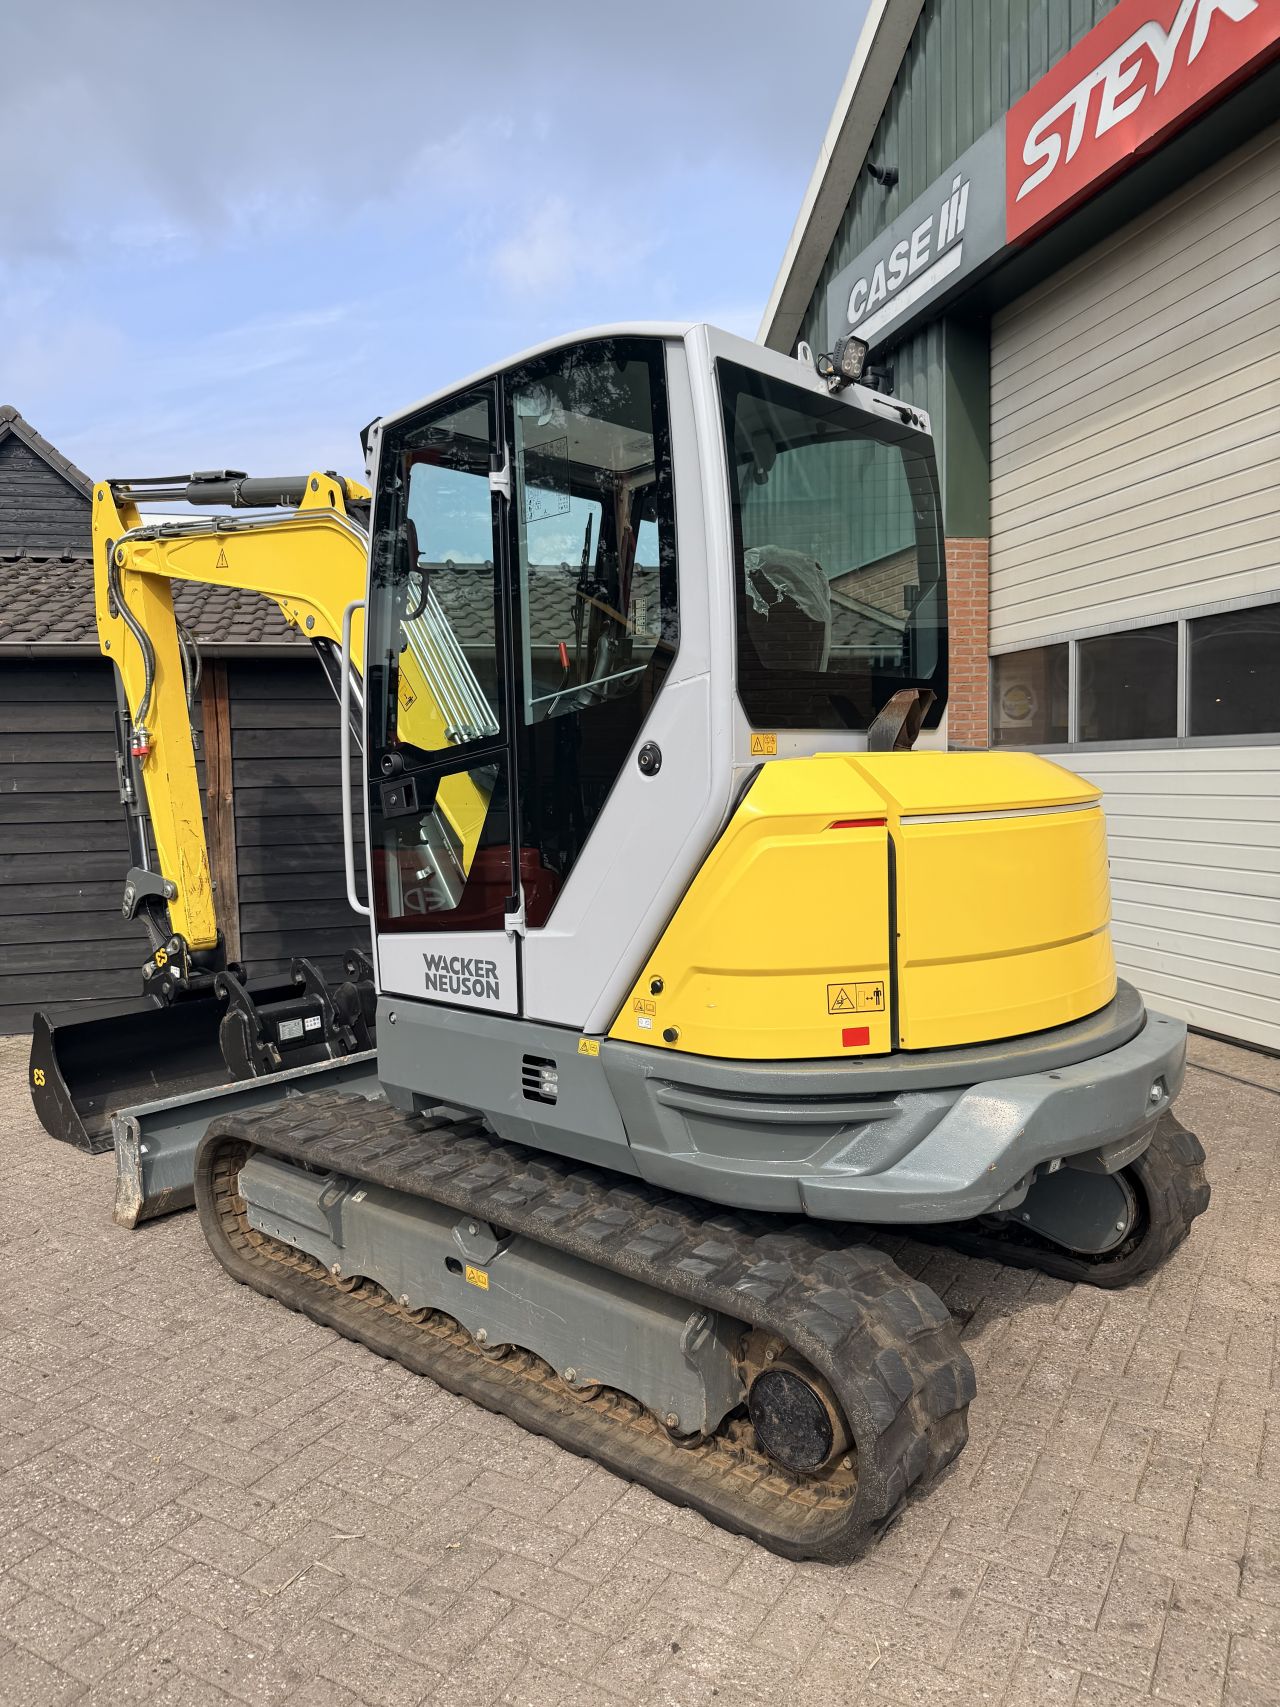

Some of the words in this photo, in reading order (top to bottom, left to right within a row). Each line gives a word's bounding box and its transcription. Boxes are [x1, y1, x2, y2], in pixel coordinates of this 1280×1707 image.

[847, 213, 934, 324] CASE
[423, 953, 499, 980] WACKER
[425, 972, 500, 1000] NEUSON
